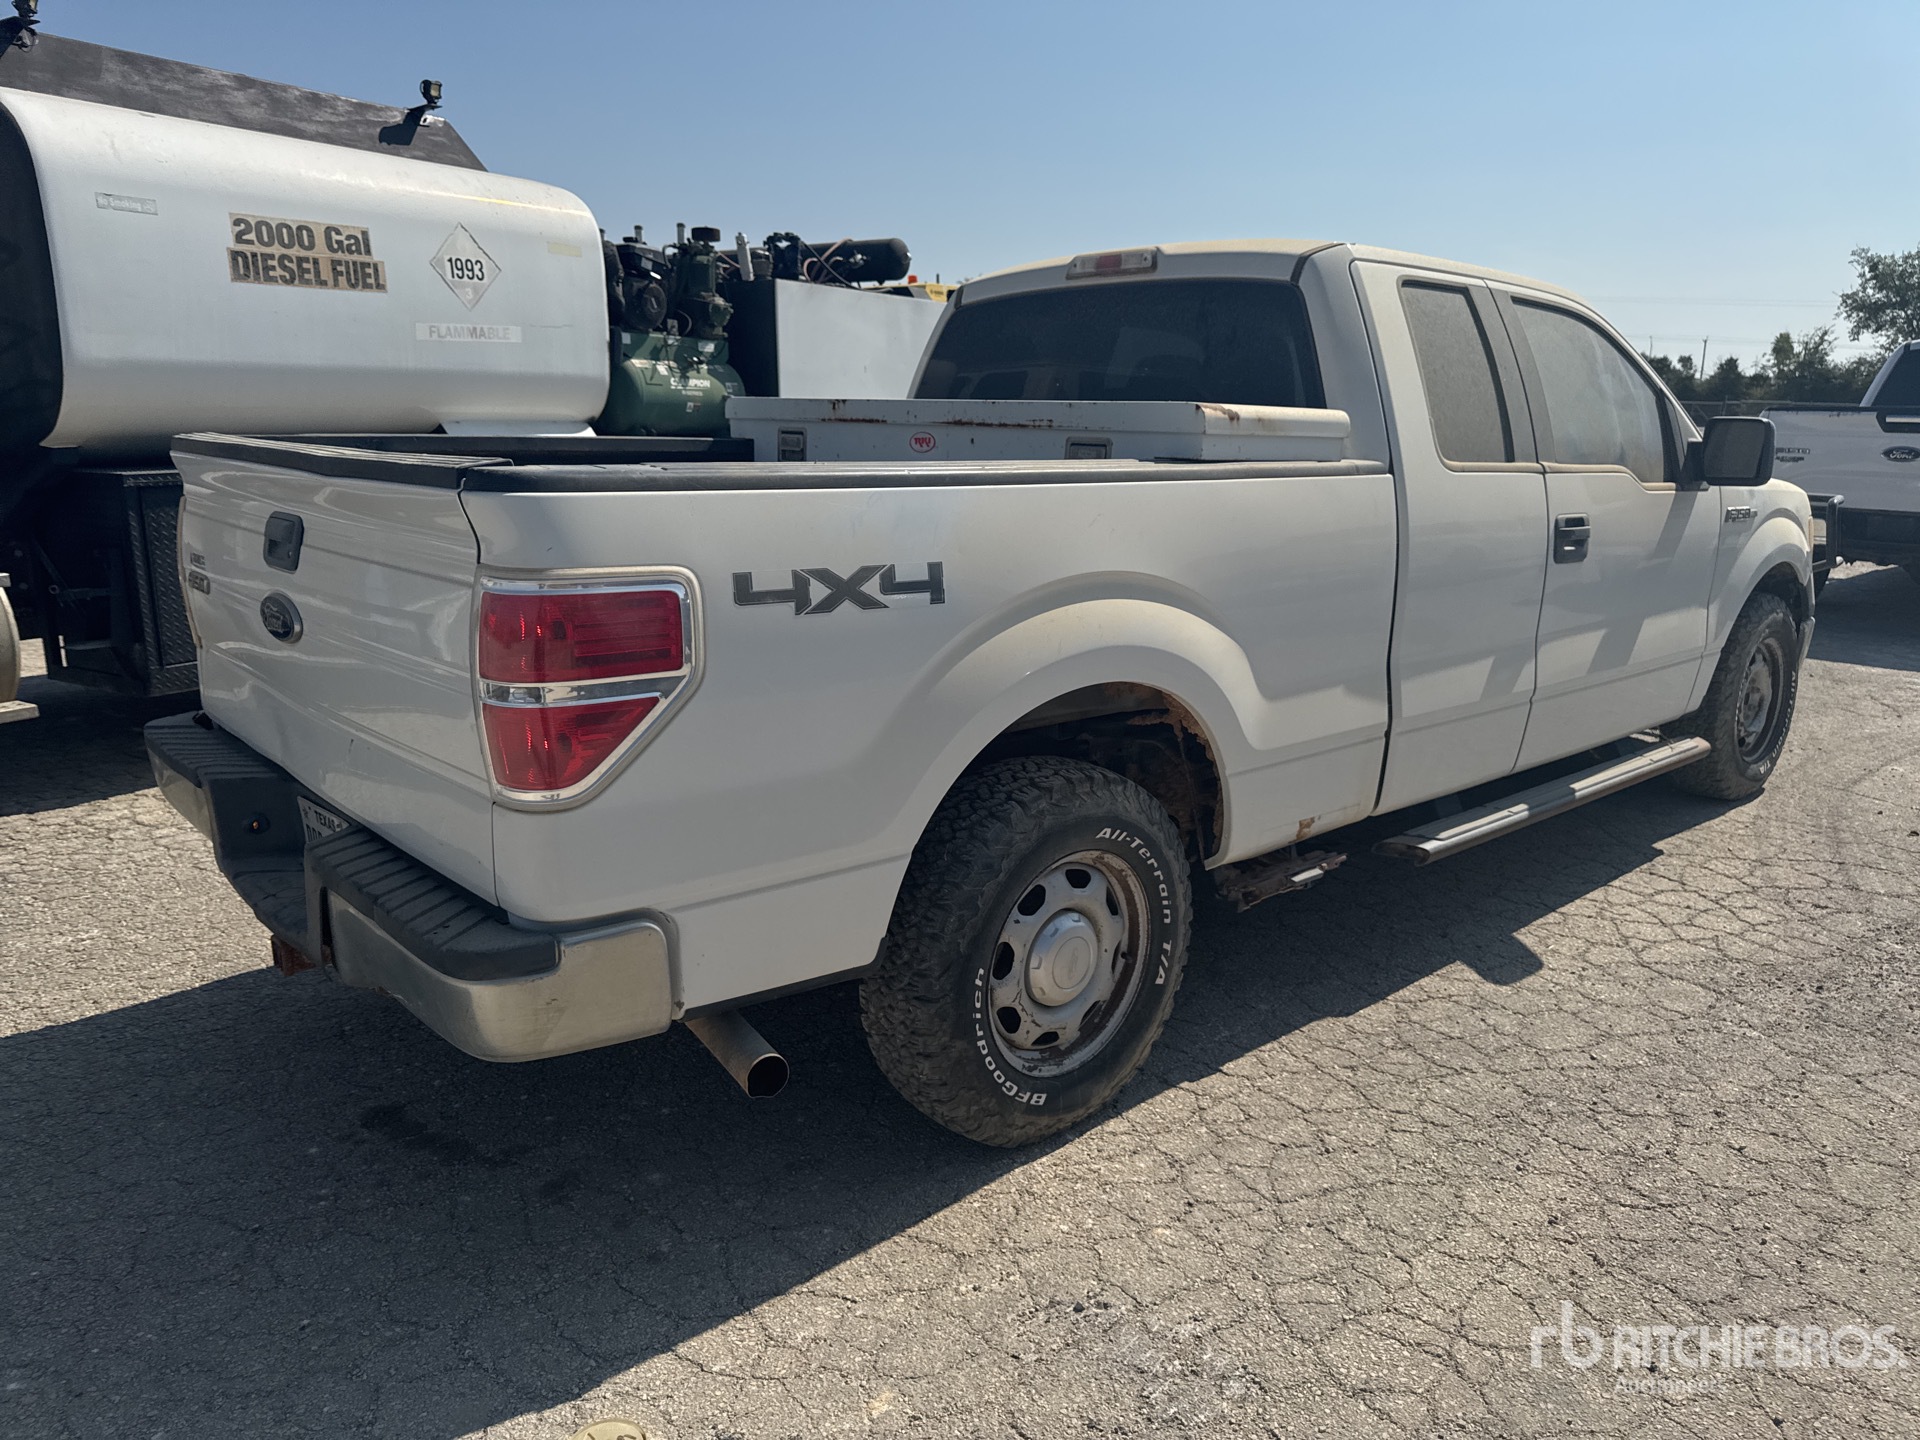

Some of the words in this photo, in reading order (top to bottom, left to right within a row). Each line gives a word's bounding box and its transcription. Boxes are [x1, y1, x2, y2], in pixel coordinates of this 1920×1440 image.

[109, 197, 142, 212] Smoking
[232, 217, 316, 251] 2000
[323, 226, 372, 257] Gal
[230, 250, 328, 286] DIESEL
[330, 259, 386, 290] FUEL
[447, 257, 485, 281] 1993
[465, 287, 474, 299] 3
[428, 324, 512, 341] FLAMMABLE
[670, 377, 711, 388] CMPION
[1095, 827, 1171, 924] All-Terrain
[1154, 939, 1172, 985] T/A
[974, 967, 1047, 1106] BFGoodrich
